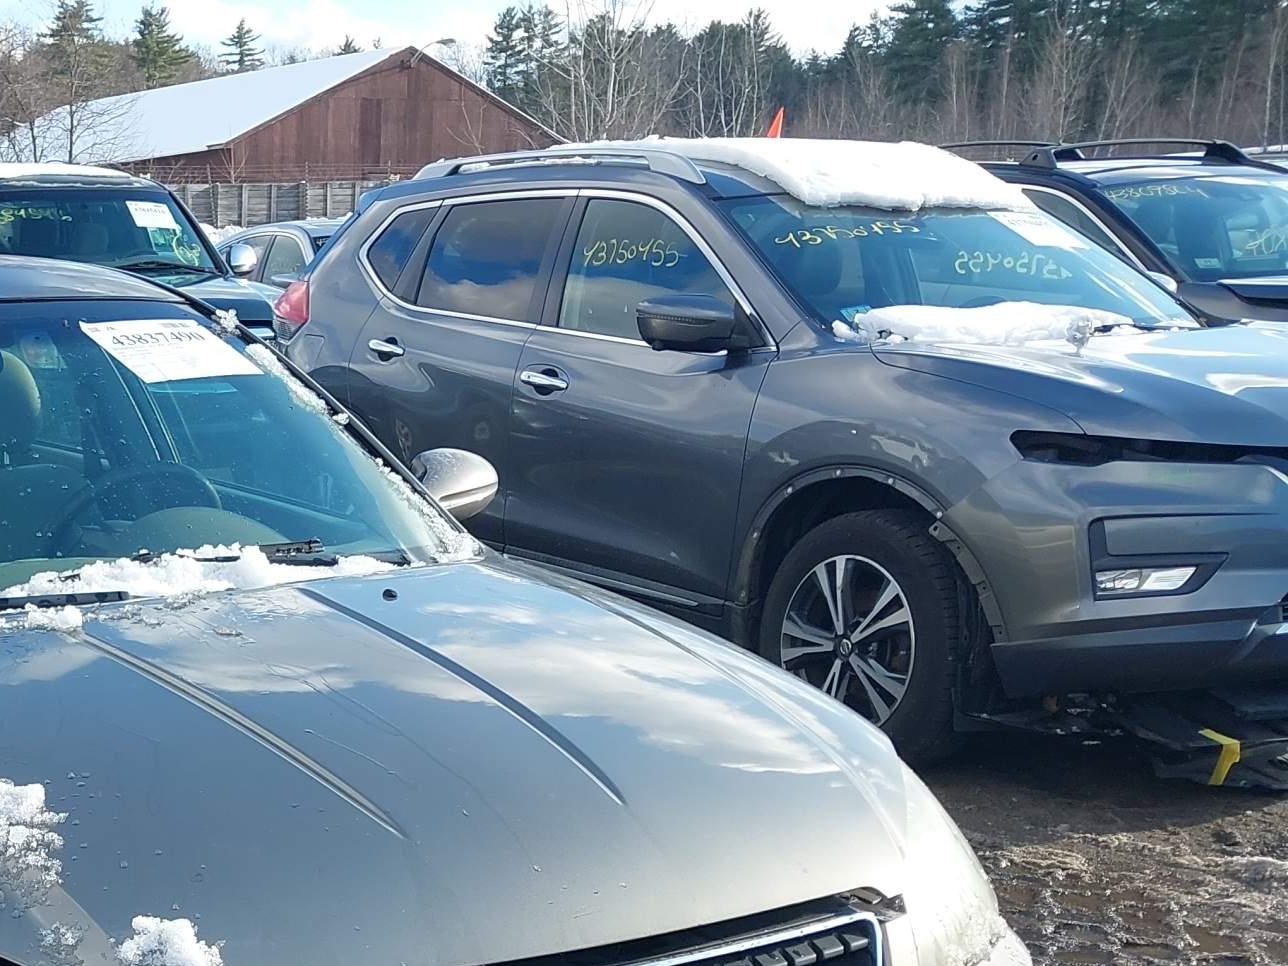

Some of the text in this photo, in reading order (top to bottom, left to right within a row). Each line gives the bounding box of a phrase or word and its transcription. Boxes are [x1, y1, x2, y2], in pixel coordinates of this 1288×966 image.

[774, 220, 920, 248] 43750455
[583, 239, 688, 267] 43750455
[112, 331, 206, 346] 43837490
